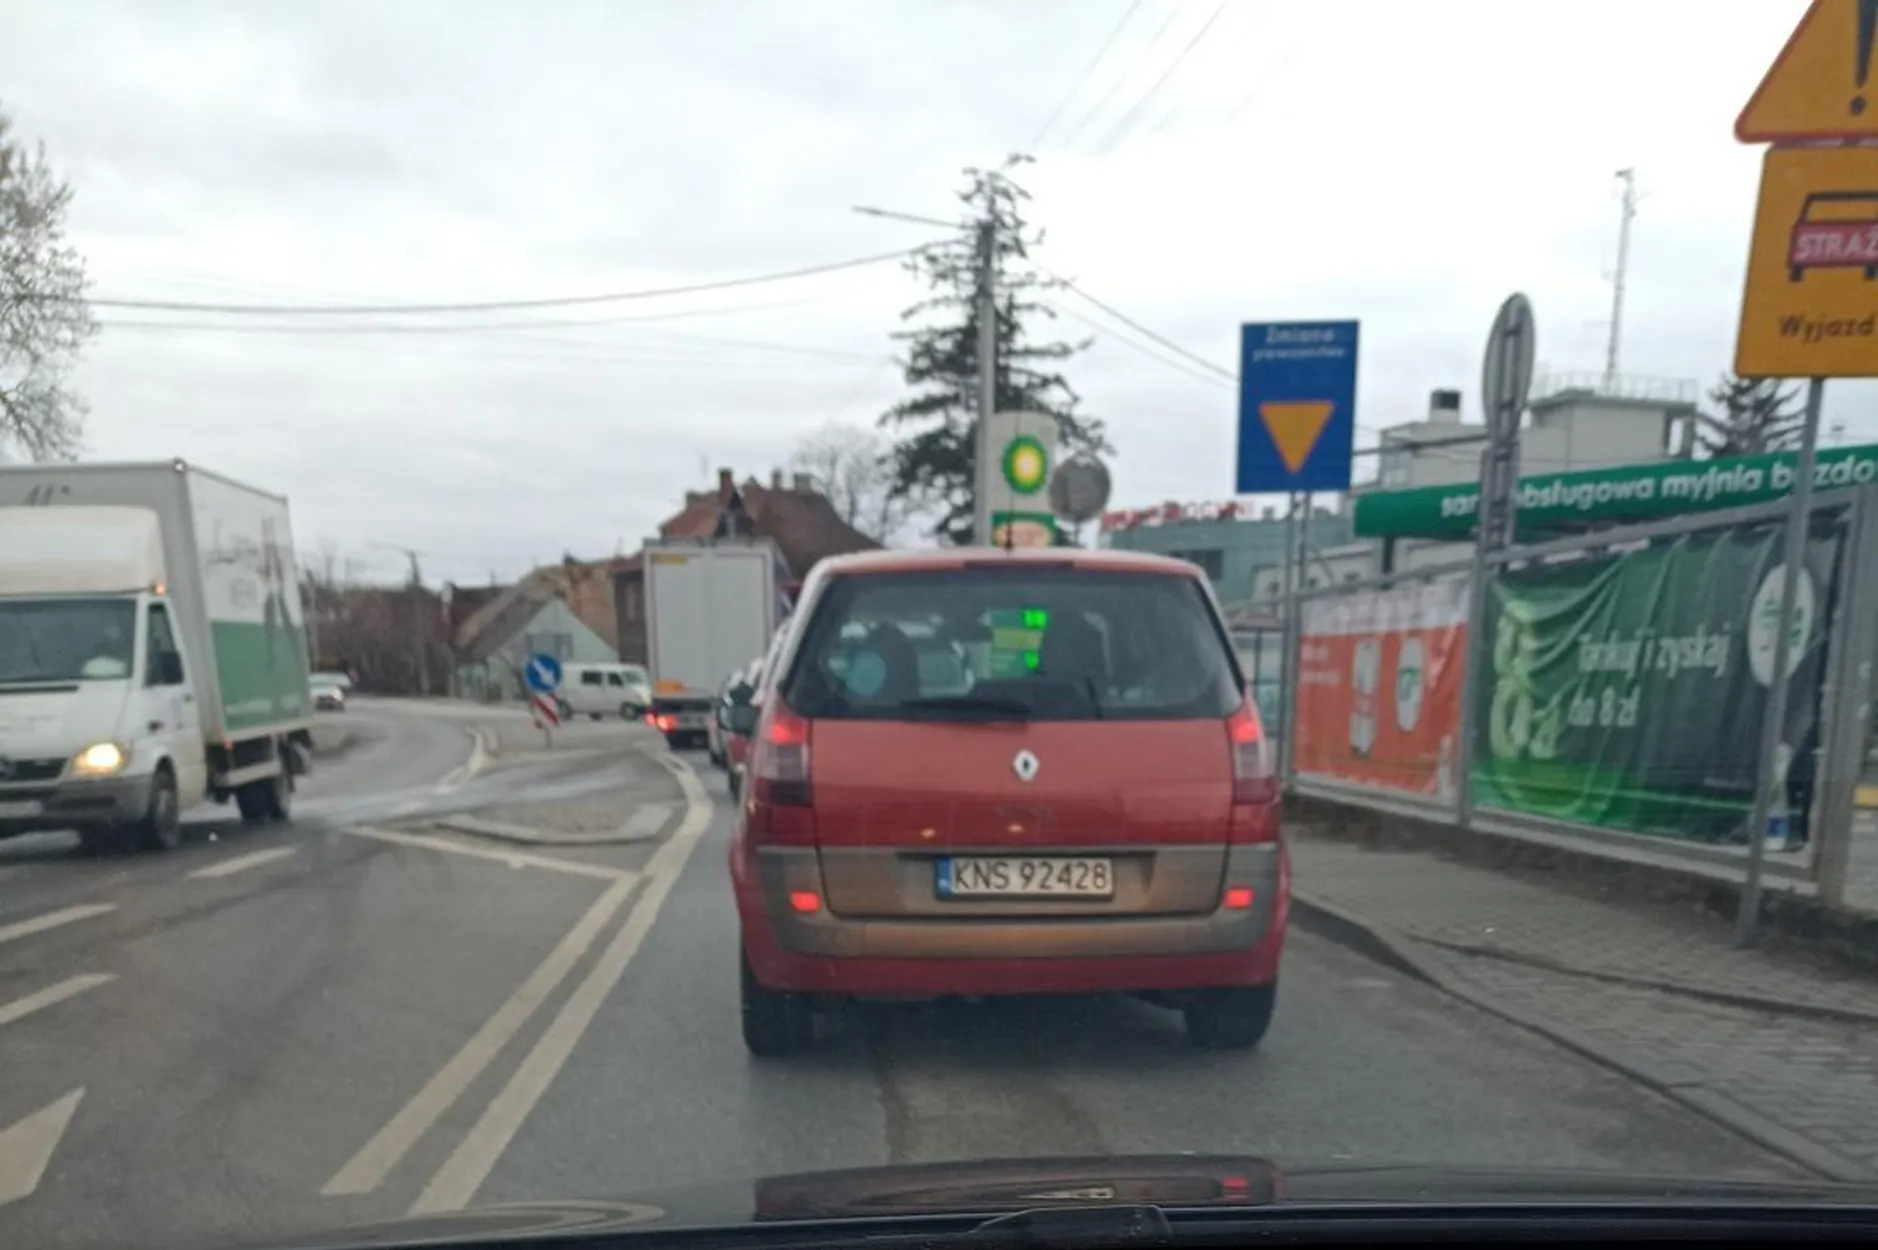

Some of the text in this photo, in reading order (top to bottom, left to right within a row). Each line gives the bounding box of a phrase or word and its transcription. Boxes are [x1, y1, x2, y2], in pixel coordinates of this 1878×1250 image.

[1780, 311, 1876, 343] Wyjazd
[1661, 464, 1763, 502] myjnia
[1771, 453, 1878, 490] bzdo
[954, 861, 1107, 891] KNS 92428
